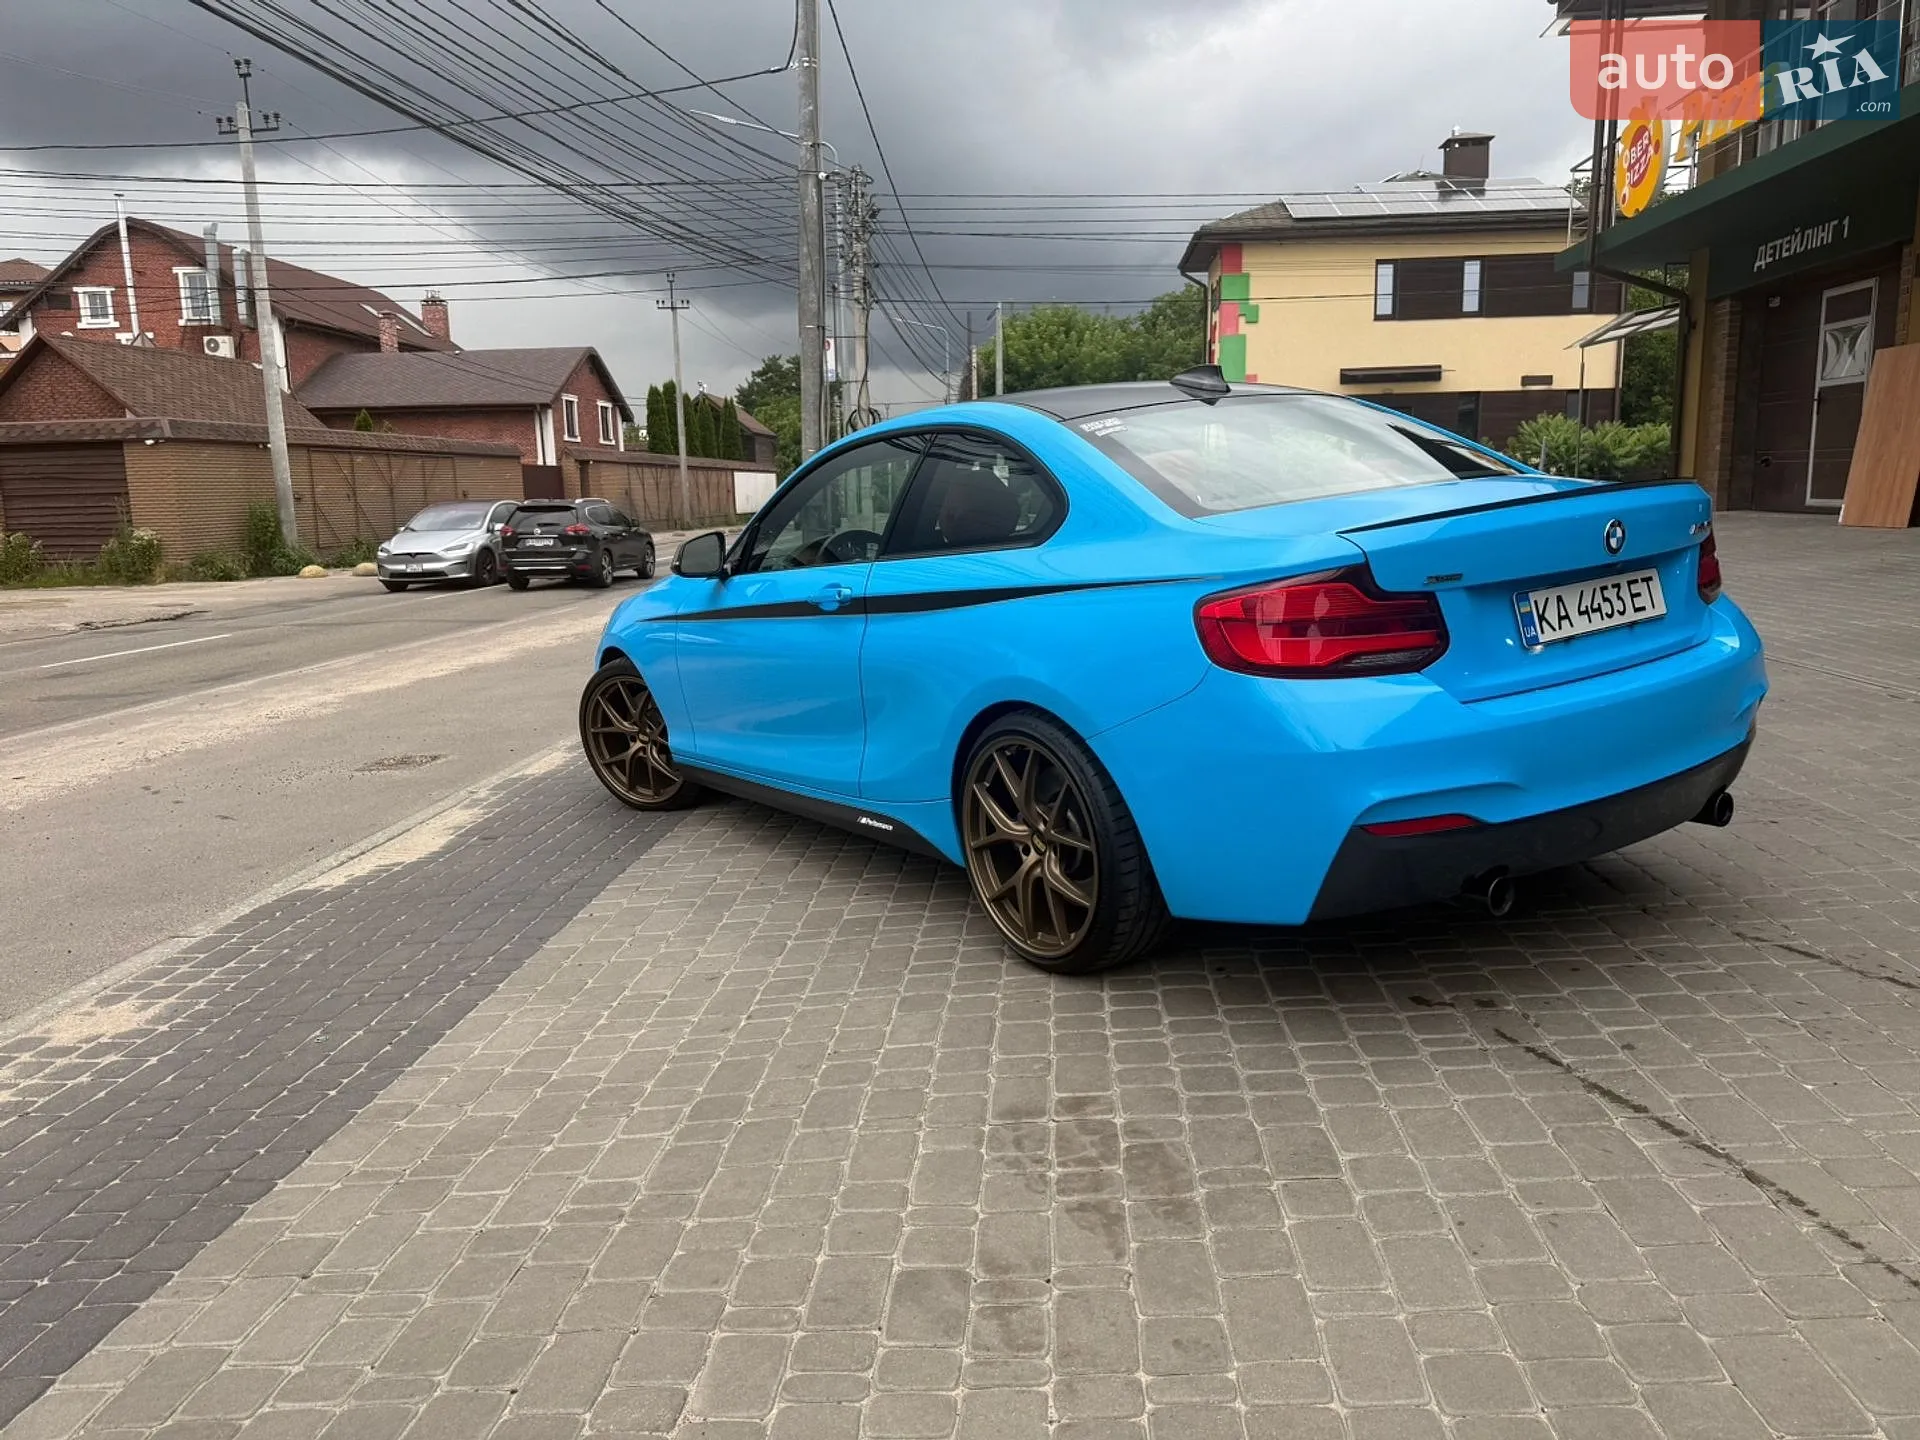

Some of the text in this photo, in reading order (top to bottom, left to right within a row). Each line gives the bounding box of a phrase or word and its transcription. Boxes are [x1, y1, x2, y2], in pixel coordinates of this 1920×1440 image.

[1626, 144, 1654, 185] PIZZA
[1753, 215, 1850, 273] ДЕТЕЙЛІНГ 1
[1534, 576, 1656, 635] KA 4453 ET
[1524, 626, 1536, 637] UA
